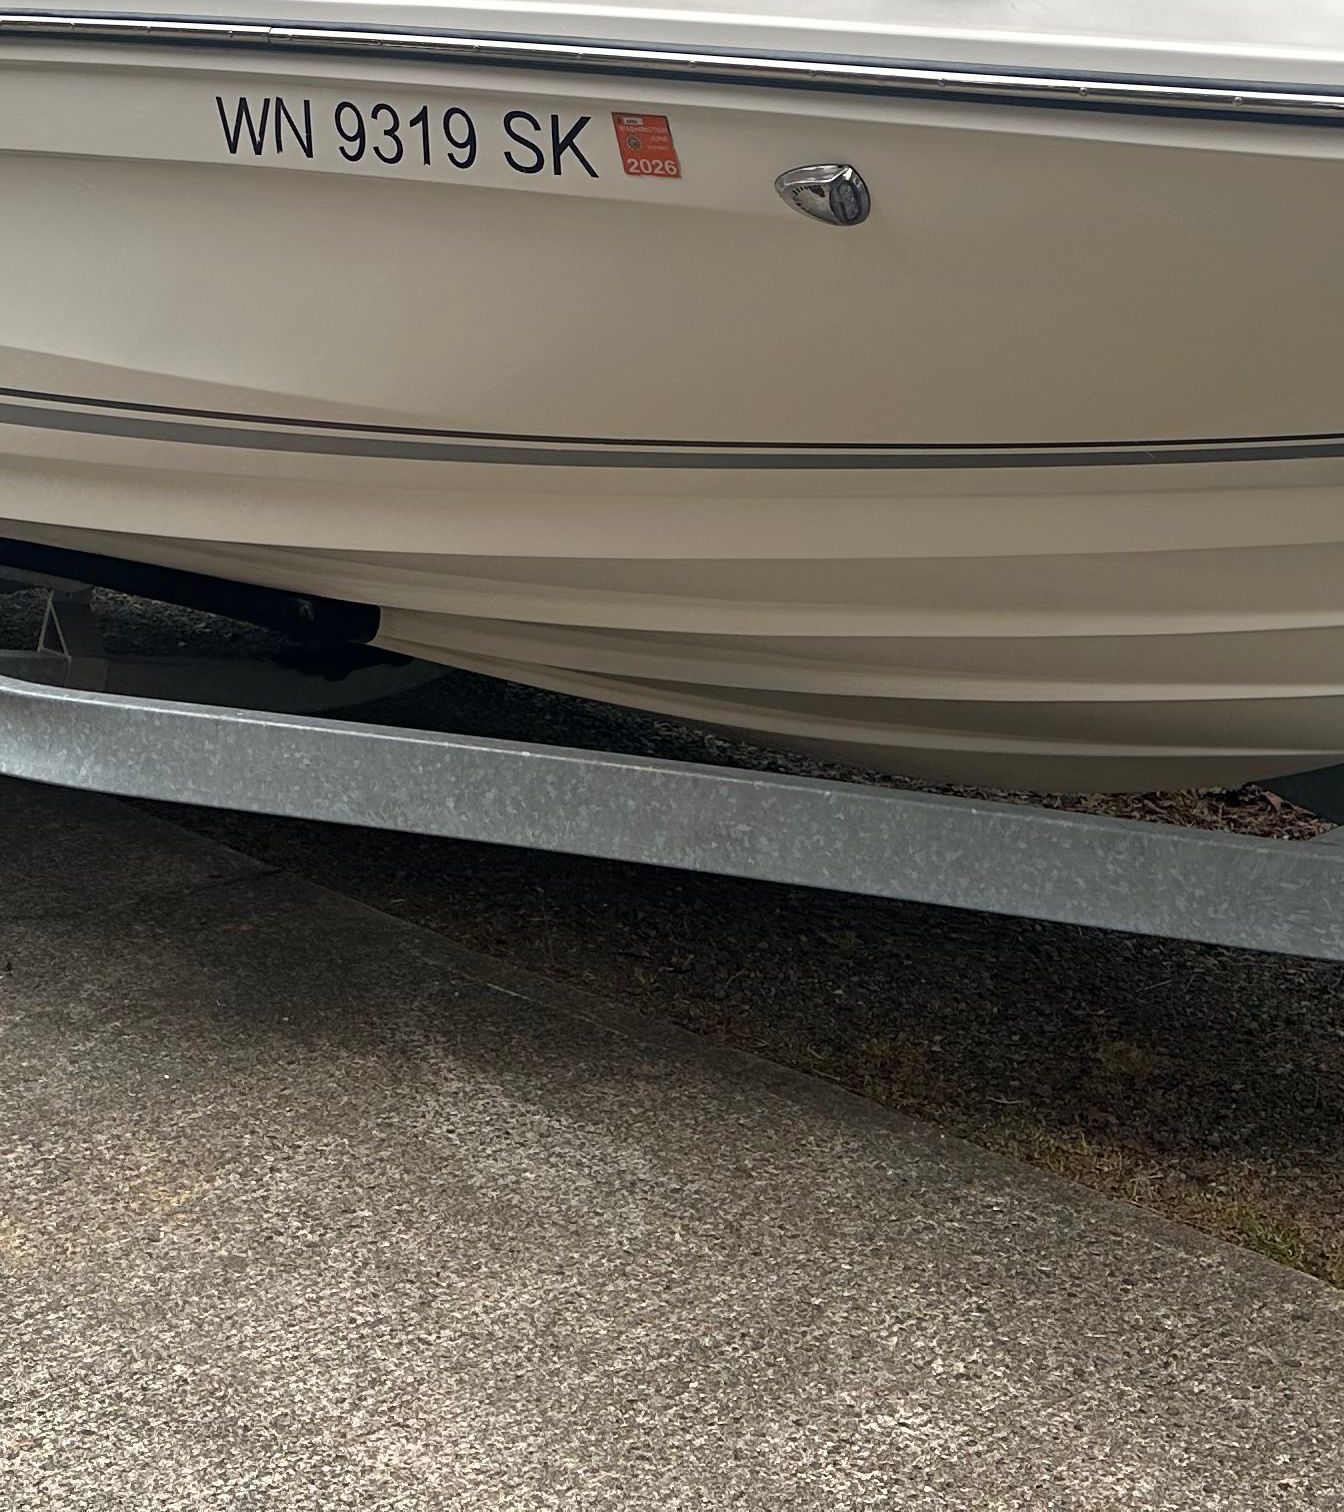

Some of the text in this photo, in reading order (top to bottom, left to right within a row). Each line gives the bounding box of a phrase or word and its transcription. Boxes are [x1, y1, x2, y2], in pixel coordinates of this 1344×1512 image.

[215, 96, 600, 178] WN 9319 SK
[626, 158, 678, 175] 2026
